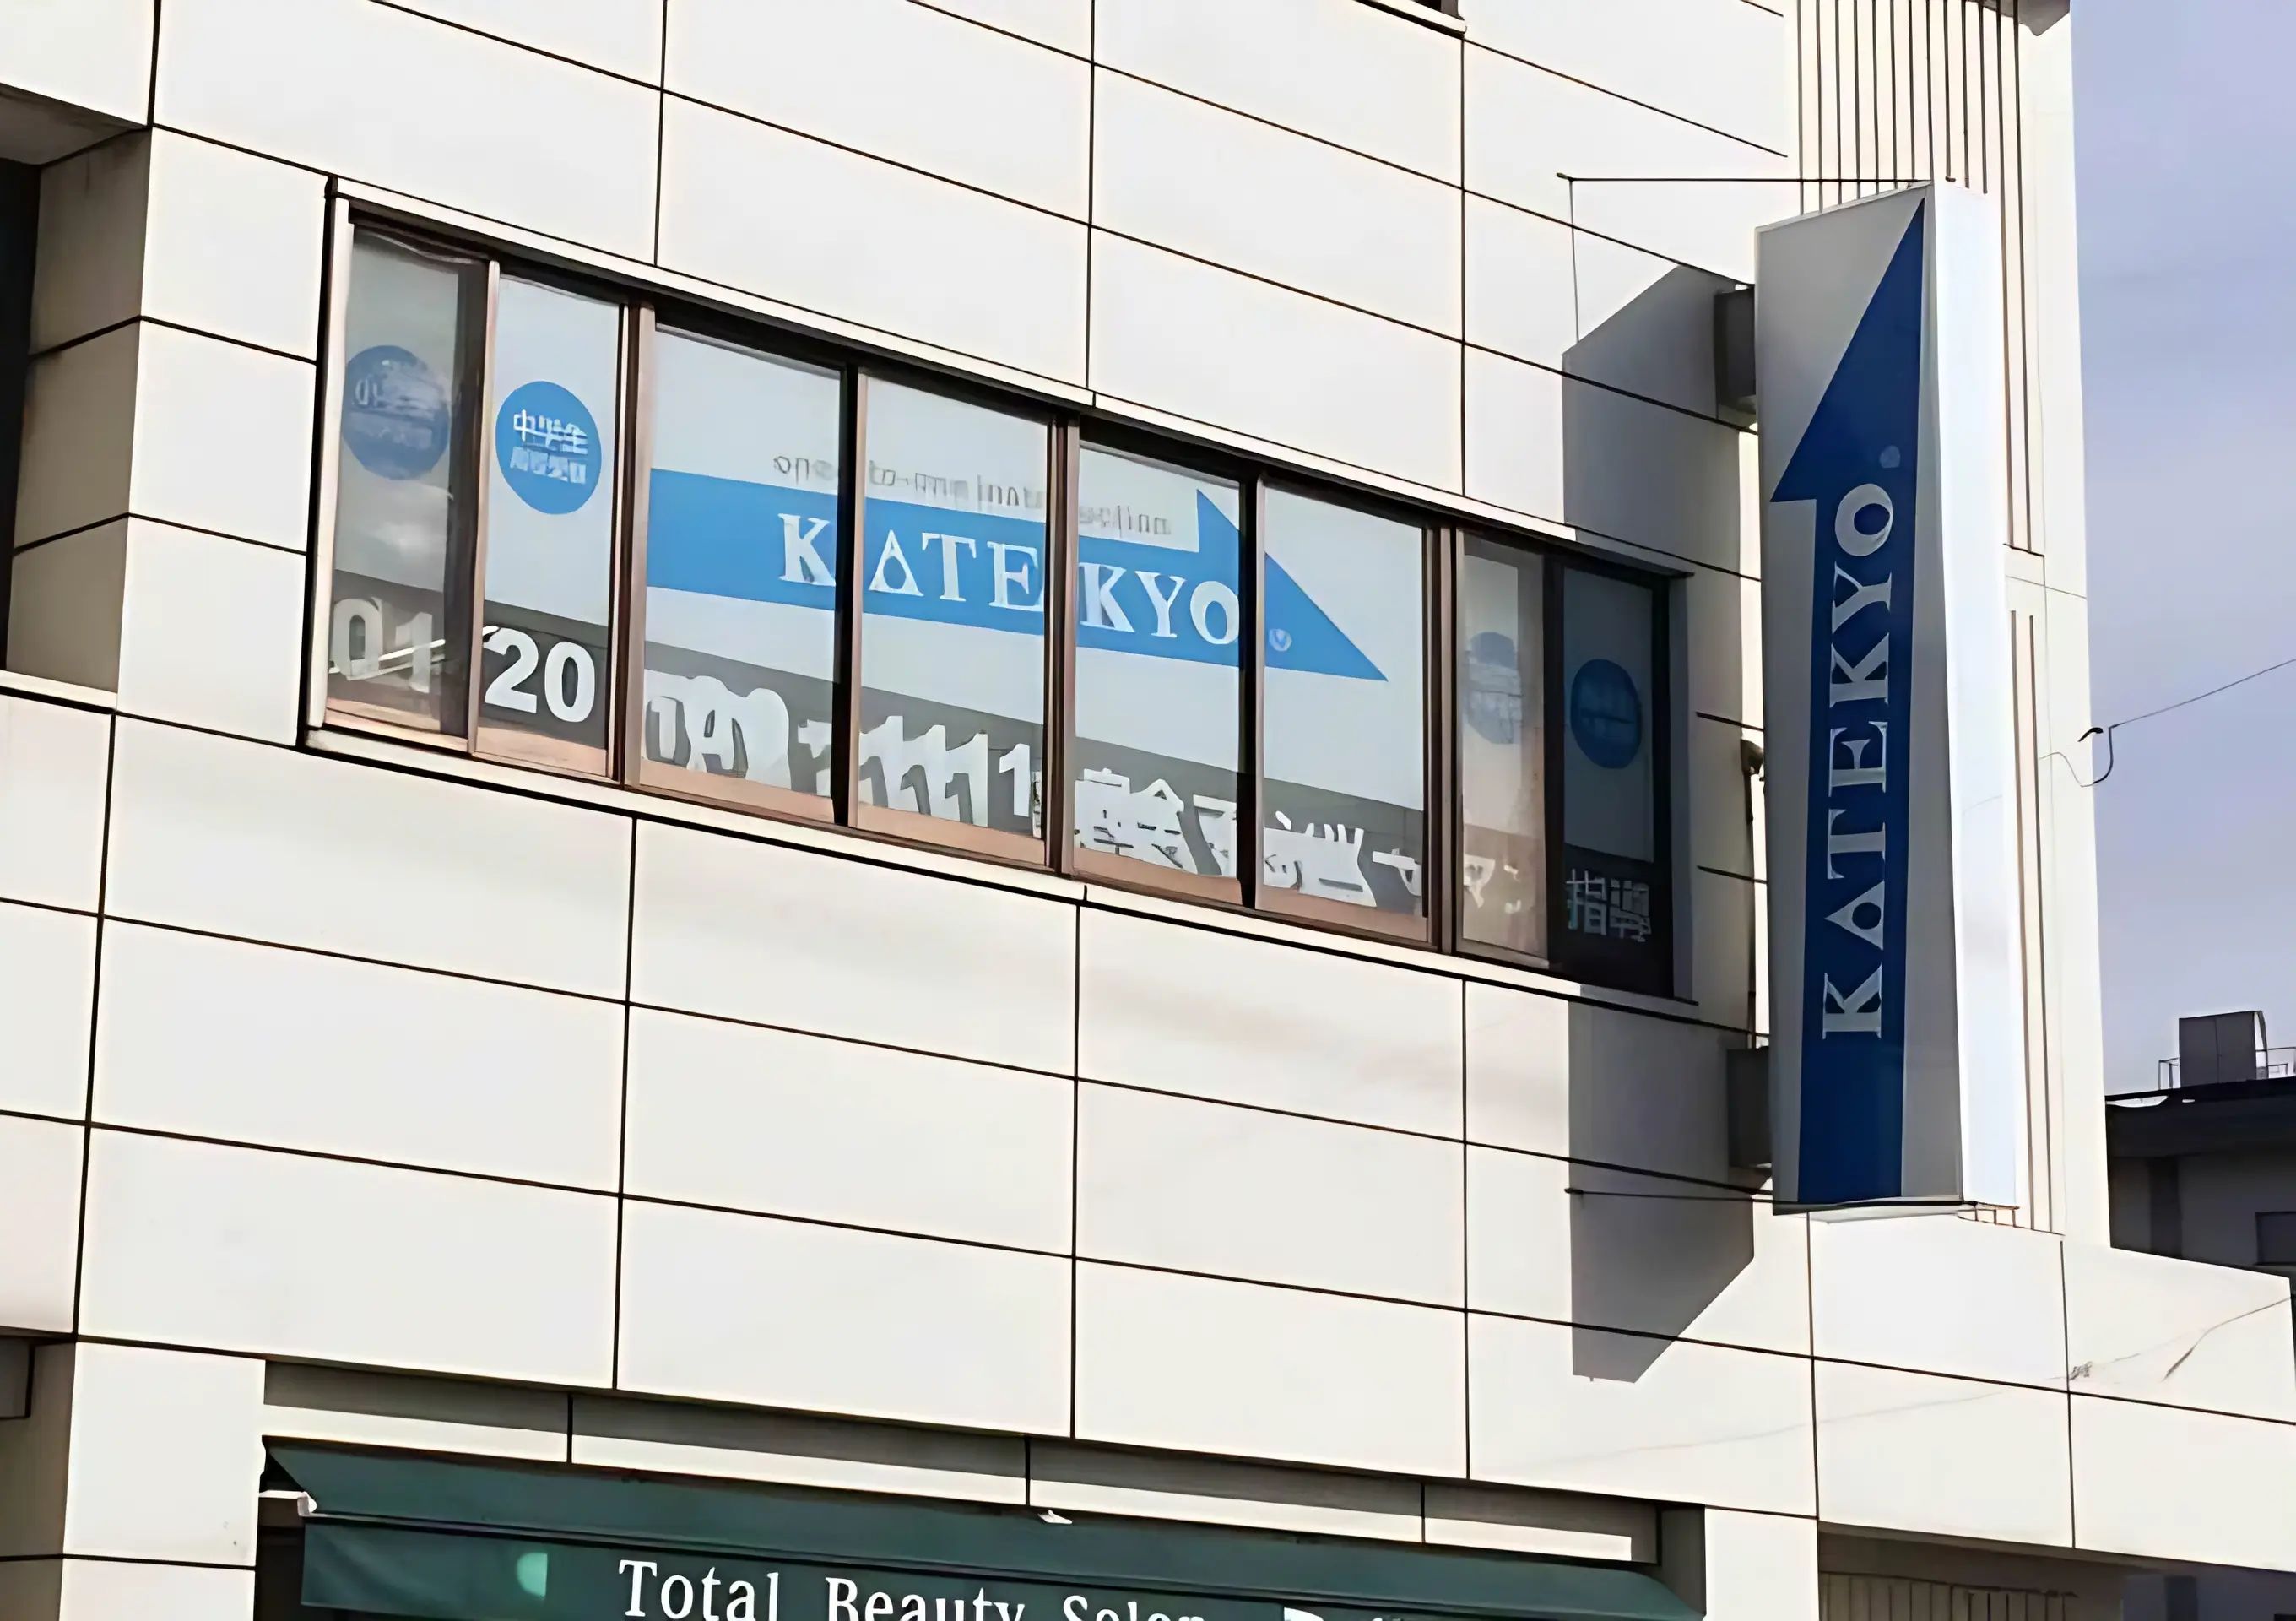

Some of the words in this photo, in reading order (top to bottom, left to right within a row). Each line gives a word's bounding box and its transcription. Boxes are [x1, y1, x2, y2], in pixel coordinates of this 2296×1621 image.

[777, 512, 1240, 645] KATEKYO
[1822, 482, 1894, 1039] KATEKYO
[618, 1559, 780, 1621] Total
